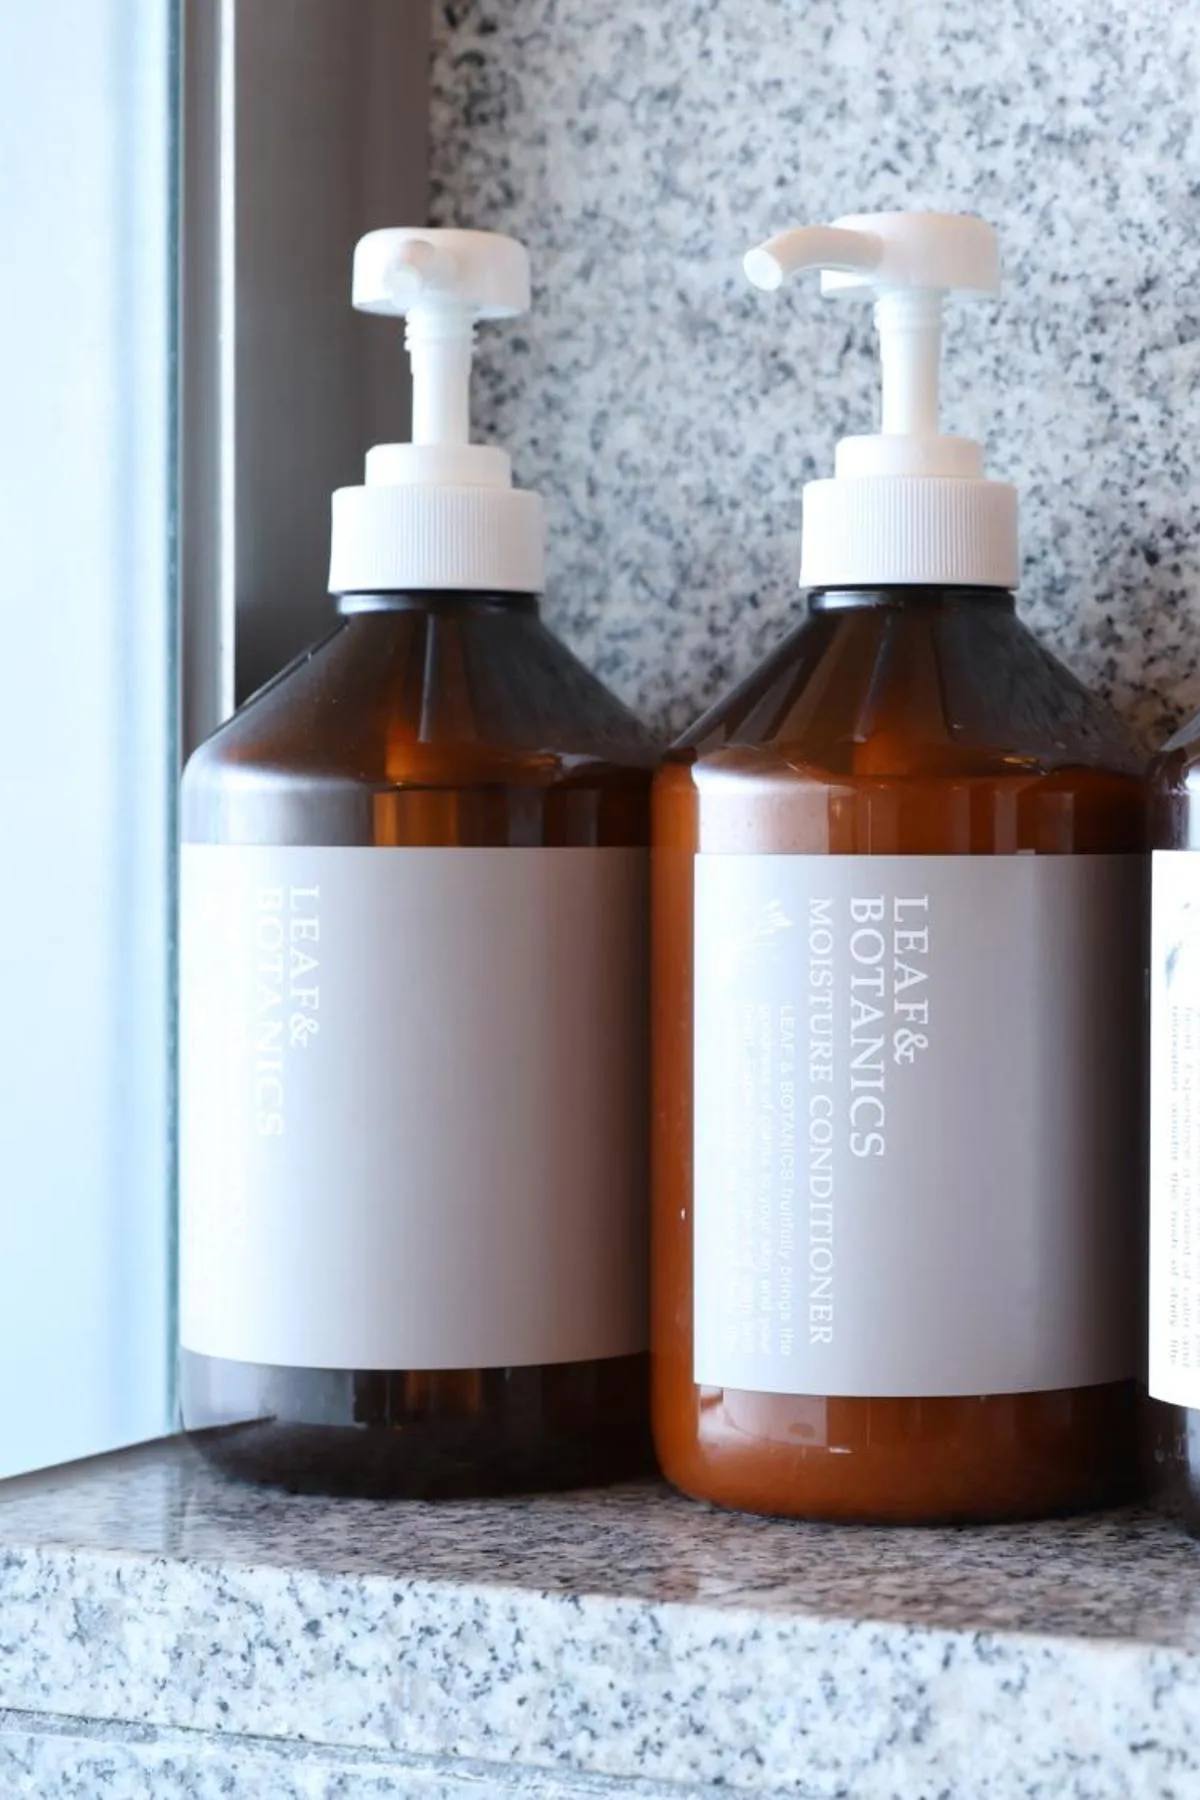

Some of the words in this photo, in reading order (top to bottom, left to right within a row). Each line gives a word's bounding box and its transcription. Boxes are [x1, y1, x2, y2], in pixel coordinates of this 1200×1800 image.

[255, 886, 284, 1136] BOTANICS
[290, 885, 320, 1050] LEAF&
[808, 897, 834, 1083] MOISTURE
[849, 895, 885, 1158] BOTANICS
[893, 895, 929, 1065] LEAF&
[808, 1094, 834, 1345] CONDITIONER
